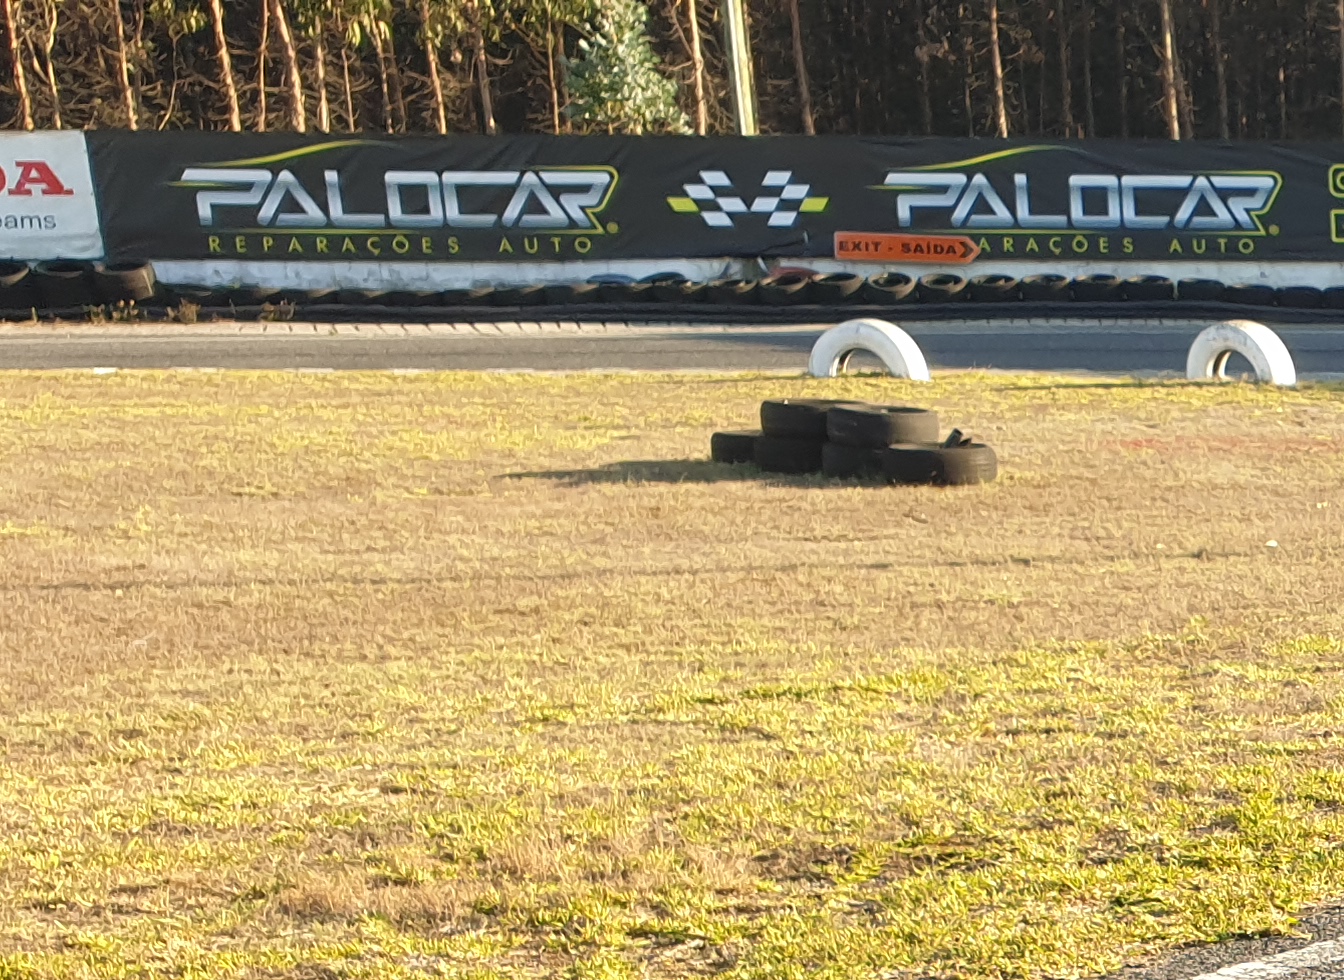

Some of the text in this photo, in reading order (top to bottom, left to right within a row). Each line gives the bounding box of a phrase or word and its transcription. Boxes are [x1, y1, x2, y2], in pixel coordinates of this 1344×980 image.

[0, 160, 74, 196] A
[181, 167, 611, 228] PALOCAR
[884, 172, 1276, 229] PALOCAR
[0, 214, 56, 230] ams
[208, 234, 593, 256] REPARAÇÕES AUTO
[839, 240, 882, 252] EXIT
[901, 242, 957, 255] SAÍDA
[978, 235, 1254, 255] ARAÇÕES AUTO
